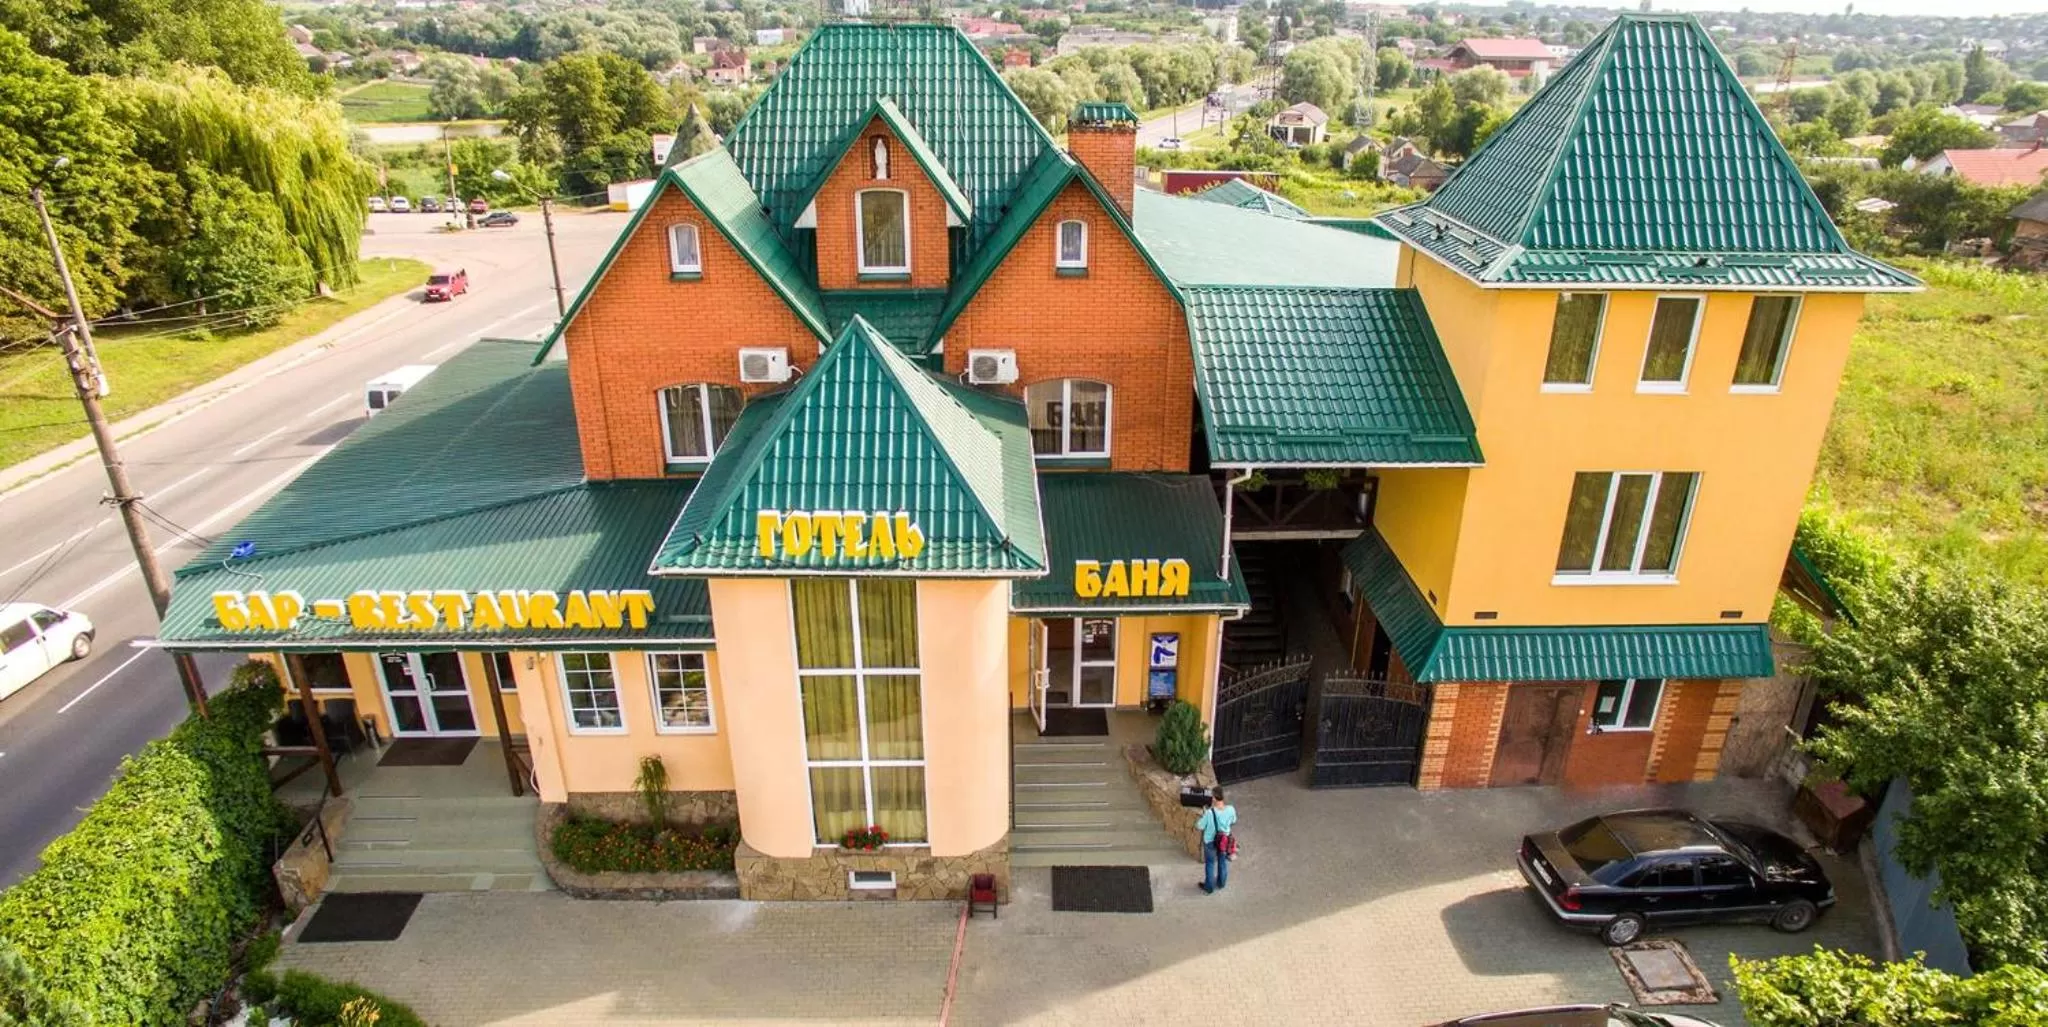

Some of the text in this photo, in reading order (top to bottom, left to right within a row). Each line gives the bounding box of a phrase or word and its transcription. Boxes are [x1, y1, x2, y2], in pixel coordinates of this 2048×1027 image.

[757, 510, 925, 559] ГОТЕЛЬ
[1074, 558, 1191, 598] БАНЯ
[211, 590, 304, 631] БАР
[347, 589, 655, 630] RESTAURANT
